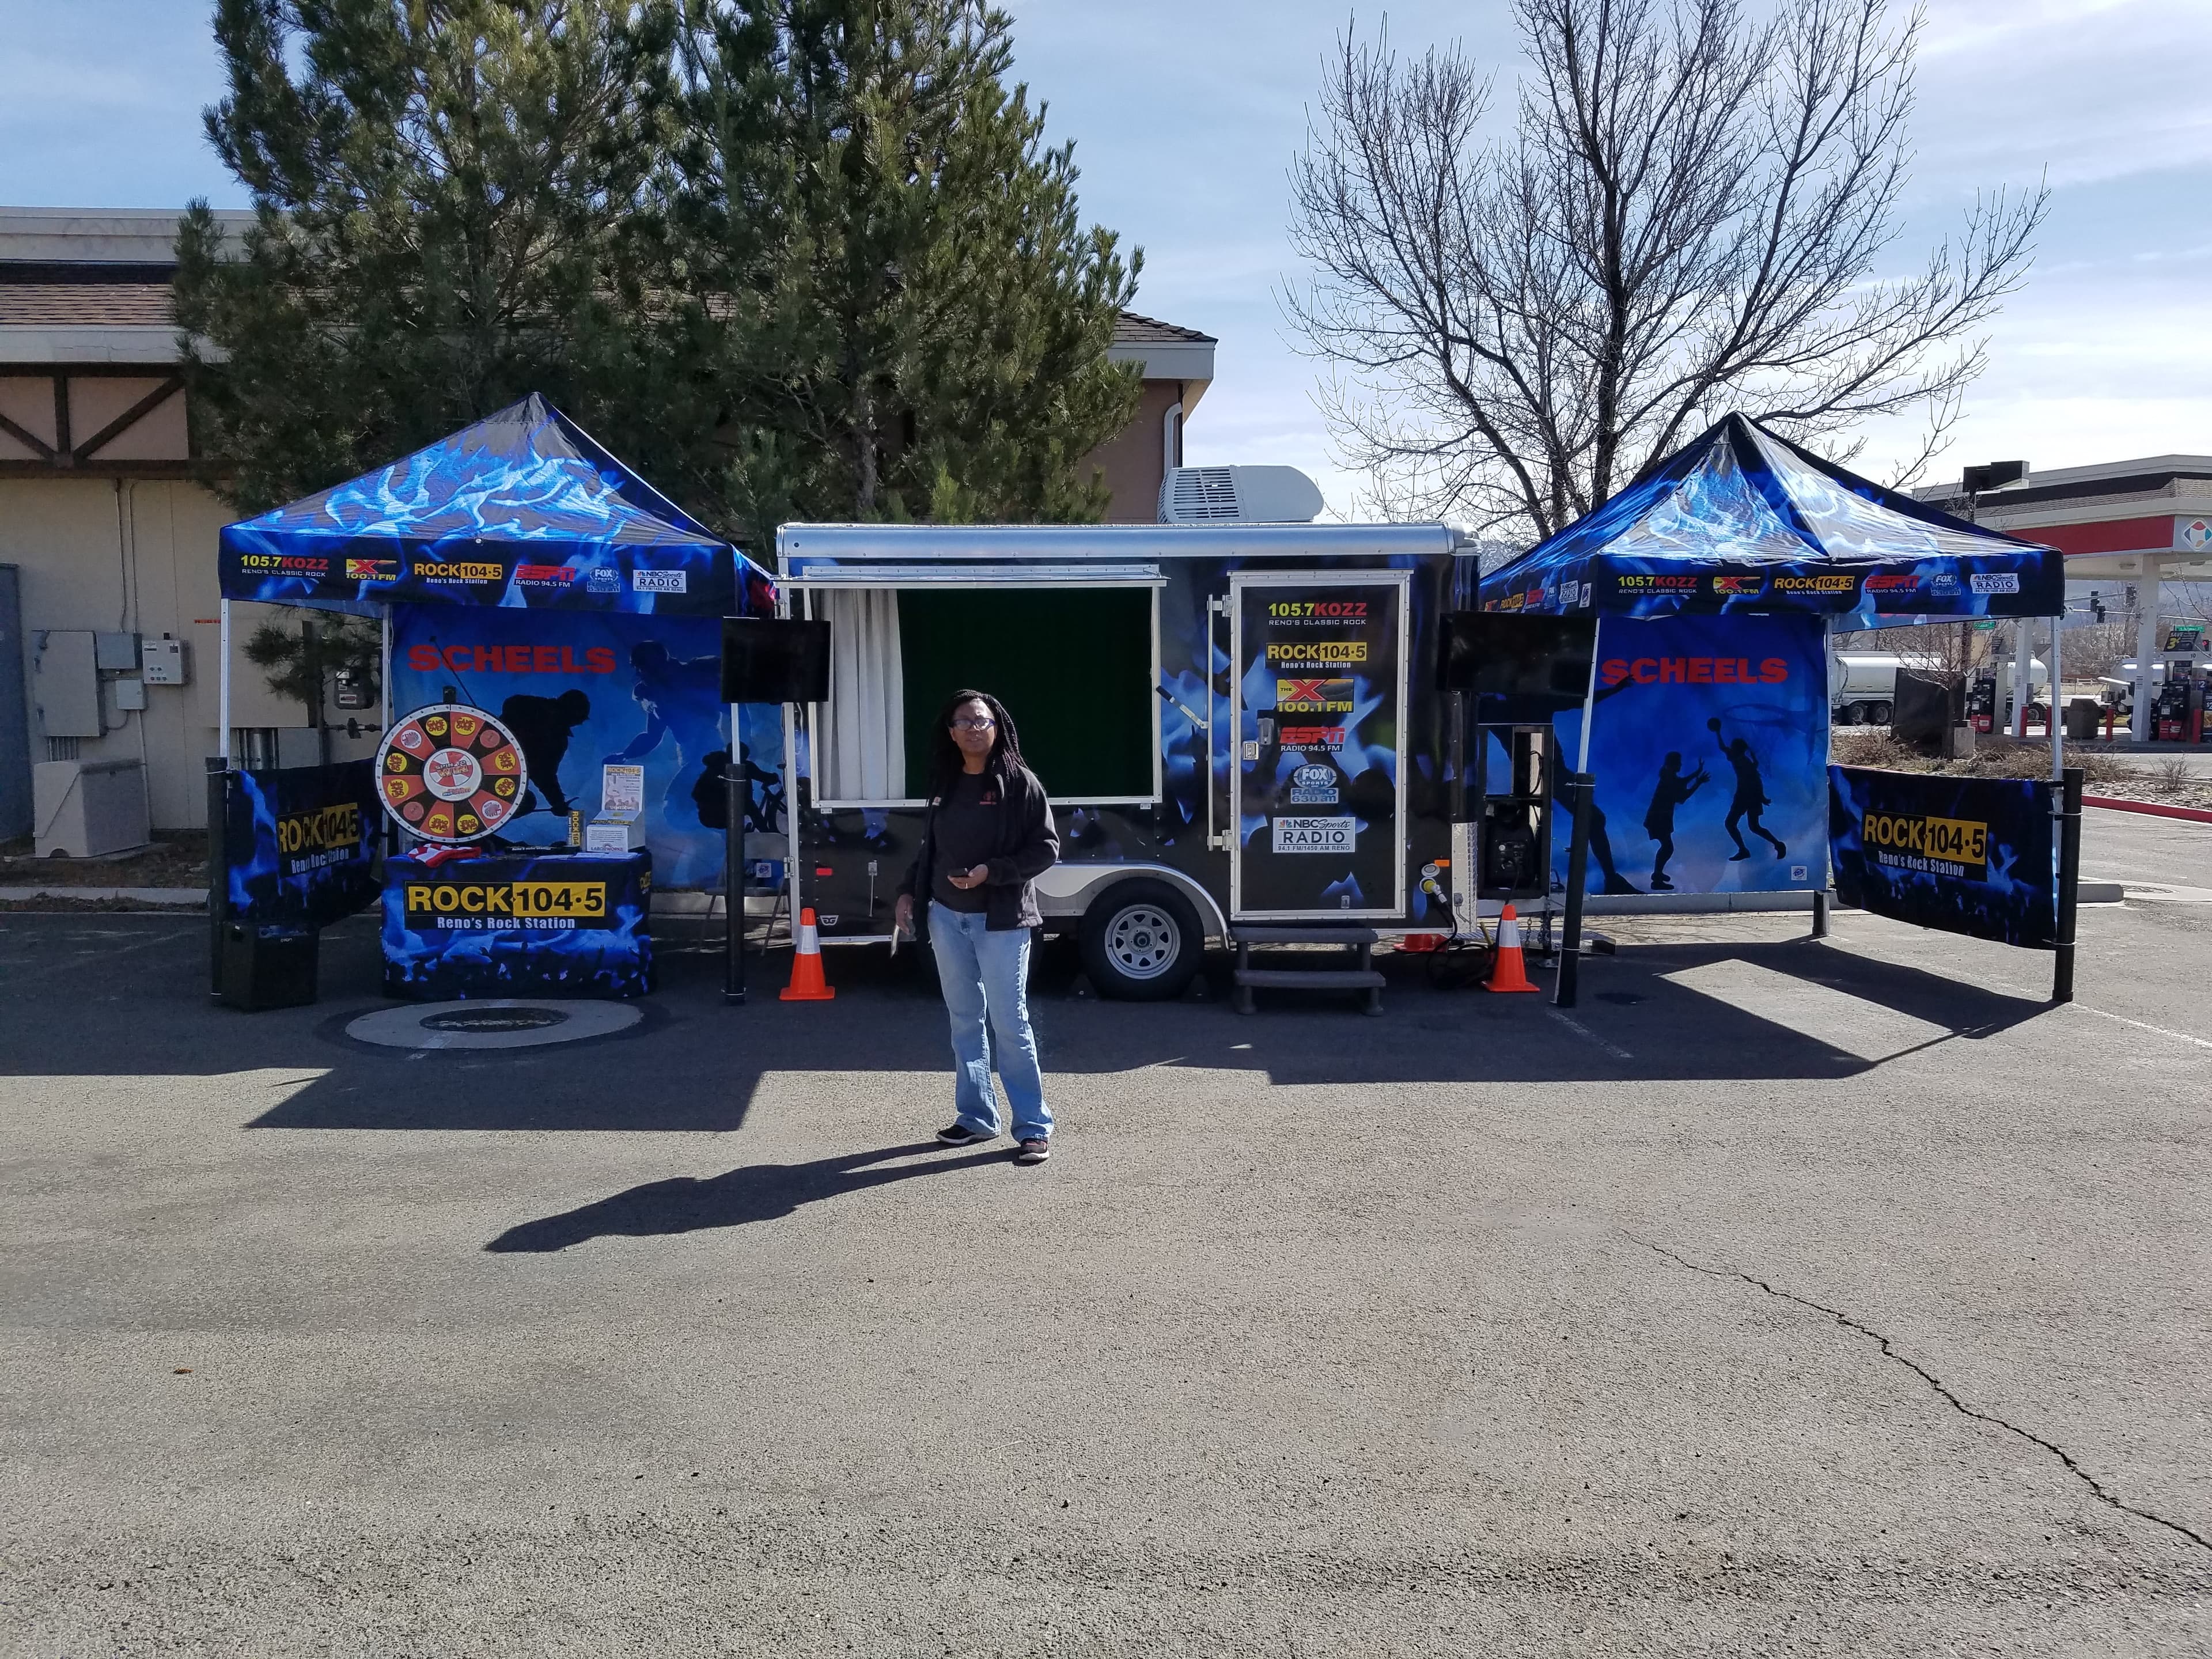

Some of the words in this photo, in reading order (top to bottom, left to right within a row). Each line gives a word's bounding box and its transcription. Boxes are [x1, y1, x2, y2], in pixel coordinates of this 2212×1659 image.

[414, 563, 460, 576] ROCK
[515, 565, 576, 581] ESPN
[594, 569, 613, 577] FOX
[639, 578, 680, 586] RADIO
[1774, 578, 1816, 589] ROCK
[1865, 576, 1919, 589] ESPN
[1268, 645, 1319, 659] ROCK
[407, 645, 616, 674] SCHEELS
[1601, 658, 1788, 684] SCHEELS
[1285, 679, 1328, 701] X
[1277, 701, 1322, 713] 100.1
[1327, 701, 1353, 712] FM
[1279, 726, 1346, 744] ESPN
[1302, 768, 1328, 780] FOX
[1283, 831, 1345, 843] RADIO
[1864, 815, 1925, 850] ROCK
[1878, 850, 1905, 867] Reno's
[1907, 855, 1928, 871] Rock
[1930, 859, 1965, 877] Station
[408, 886, 512, 912] ROCK
[437, 917, 483, 929] Reno's
[487, 917, 521, 929] Rock
[525, 917, 575, 929] Station
